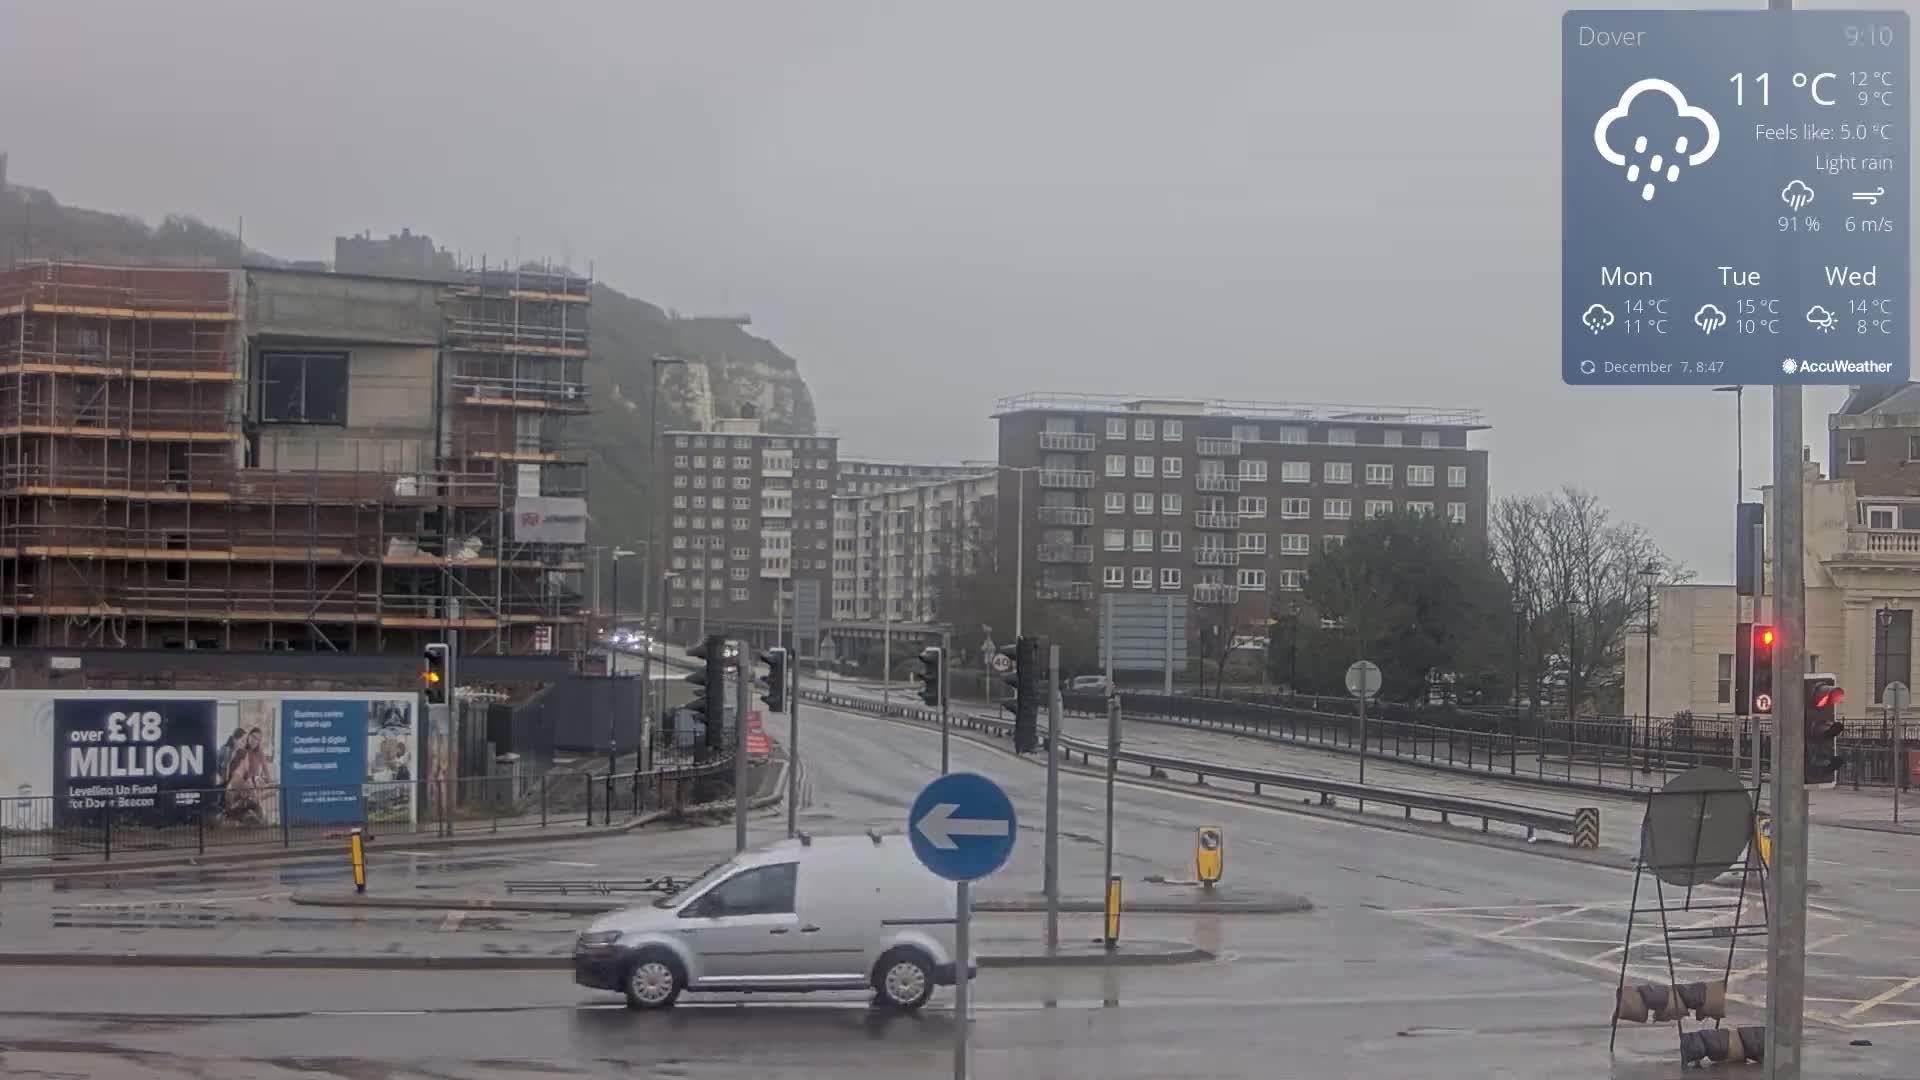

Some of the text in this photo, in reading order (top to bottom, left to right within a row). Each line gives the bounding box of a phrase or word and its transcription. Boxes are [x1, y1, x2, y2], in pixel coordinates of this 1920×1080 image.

[71, 711, 162, 742] over £18
[70, 745, 204, 777] MILLION
[132, 784, 158, 795] Fund
[85, 797, 115, 808] Dovr
[119, 797, 154, 808] Beacon
